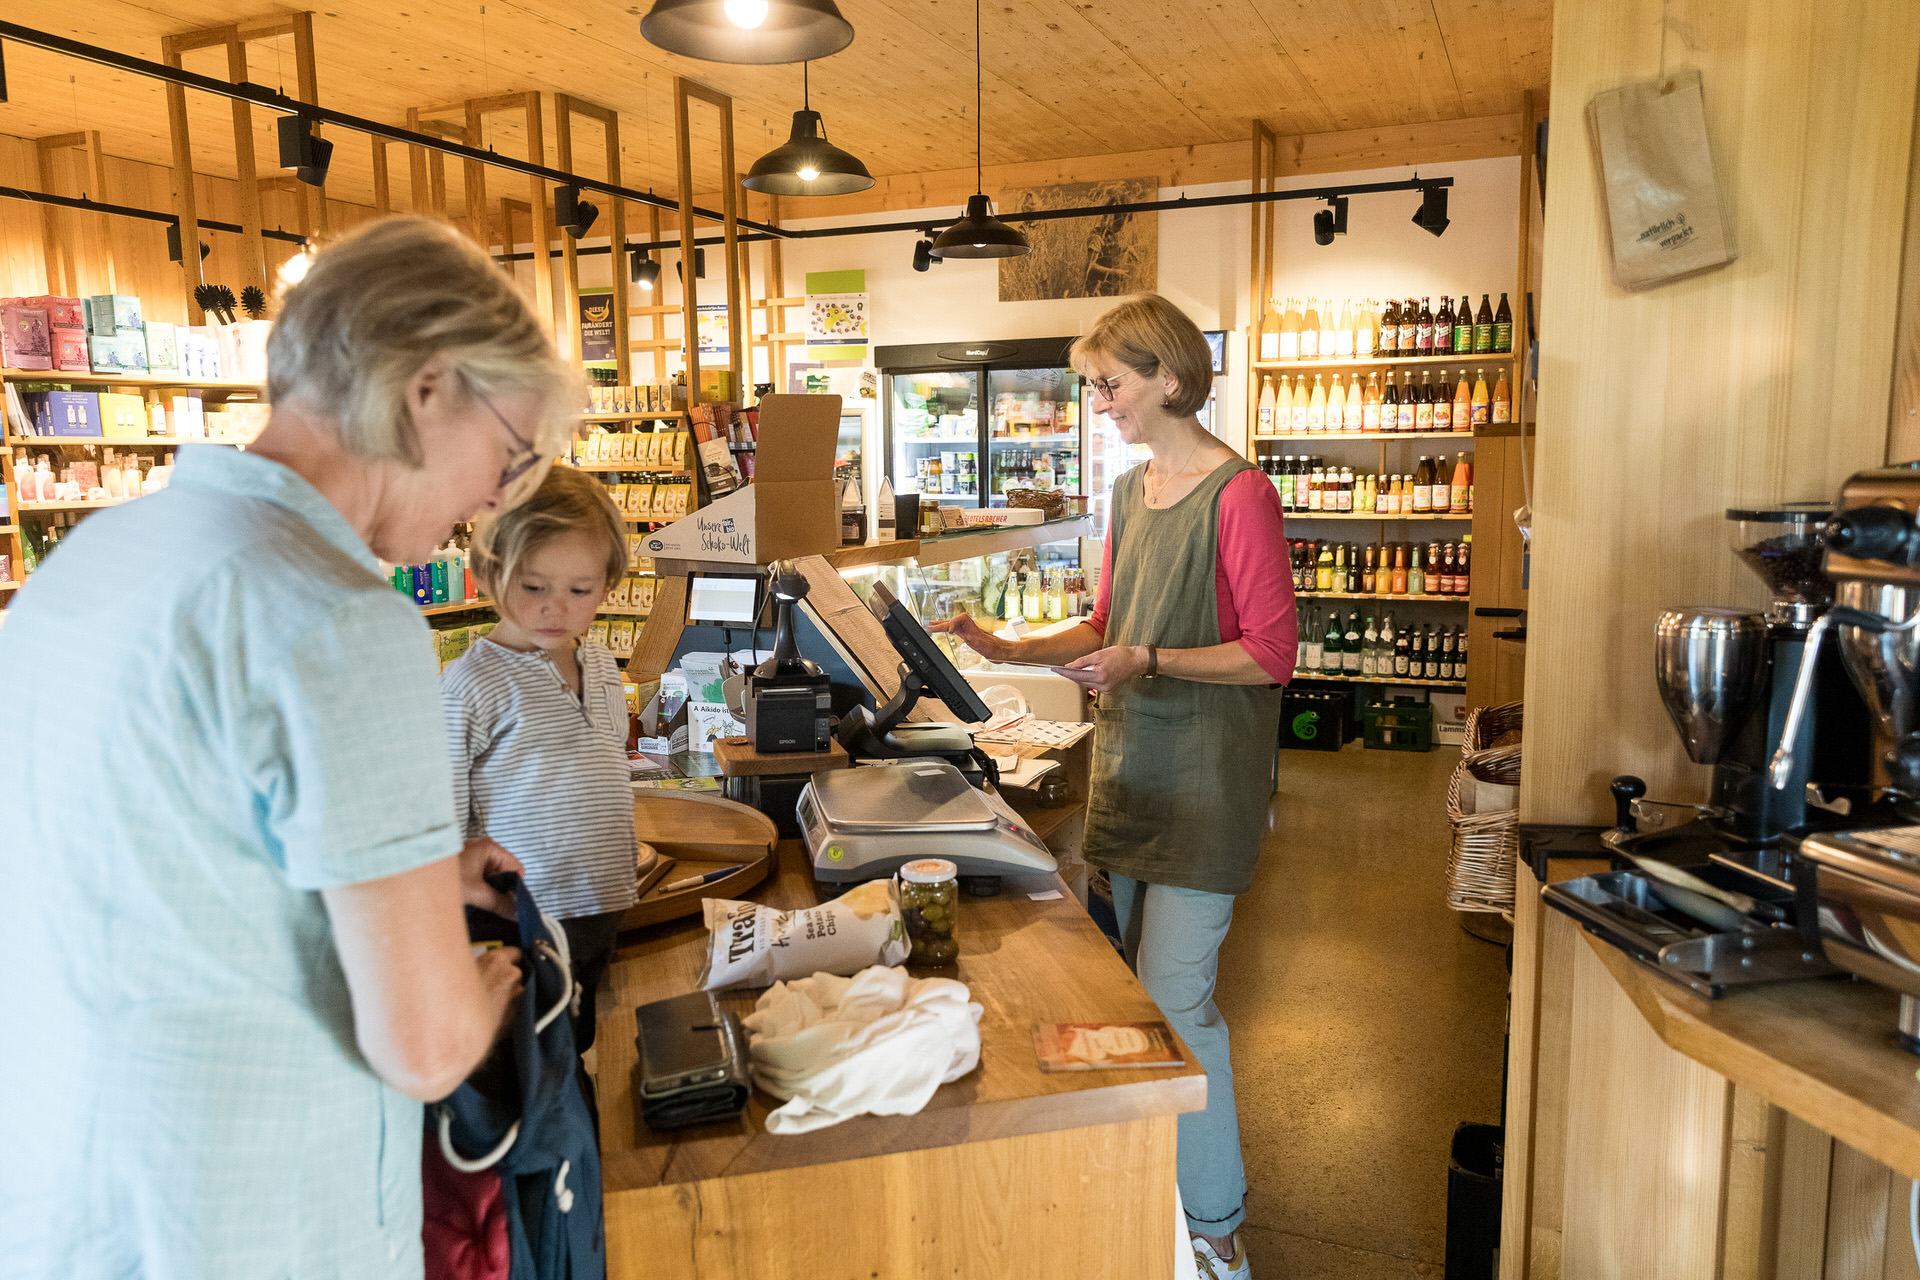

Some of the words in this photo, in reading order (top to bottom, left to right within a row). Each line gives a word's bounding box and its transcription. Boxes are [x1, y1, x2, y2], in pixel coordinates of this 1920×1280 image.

[1640, 218, 1675, 240] natürlich
[1660, 226, 1693, 247] verpackt
[697, 517, 722, 533] Unsere
[966, 514, 1008, 524] EUTELSBACHER
[701, 533, 751, 556] Schoko-Welt
[806, 922, 816, 940] Sea
[815, 911, 826, 938] Potato
[825, 910, 837, 936] Chips
